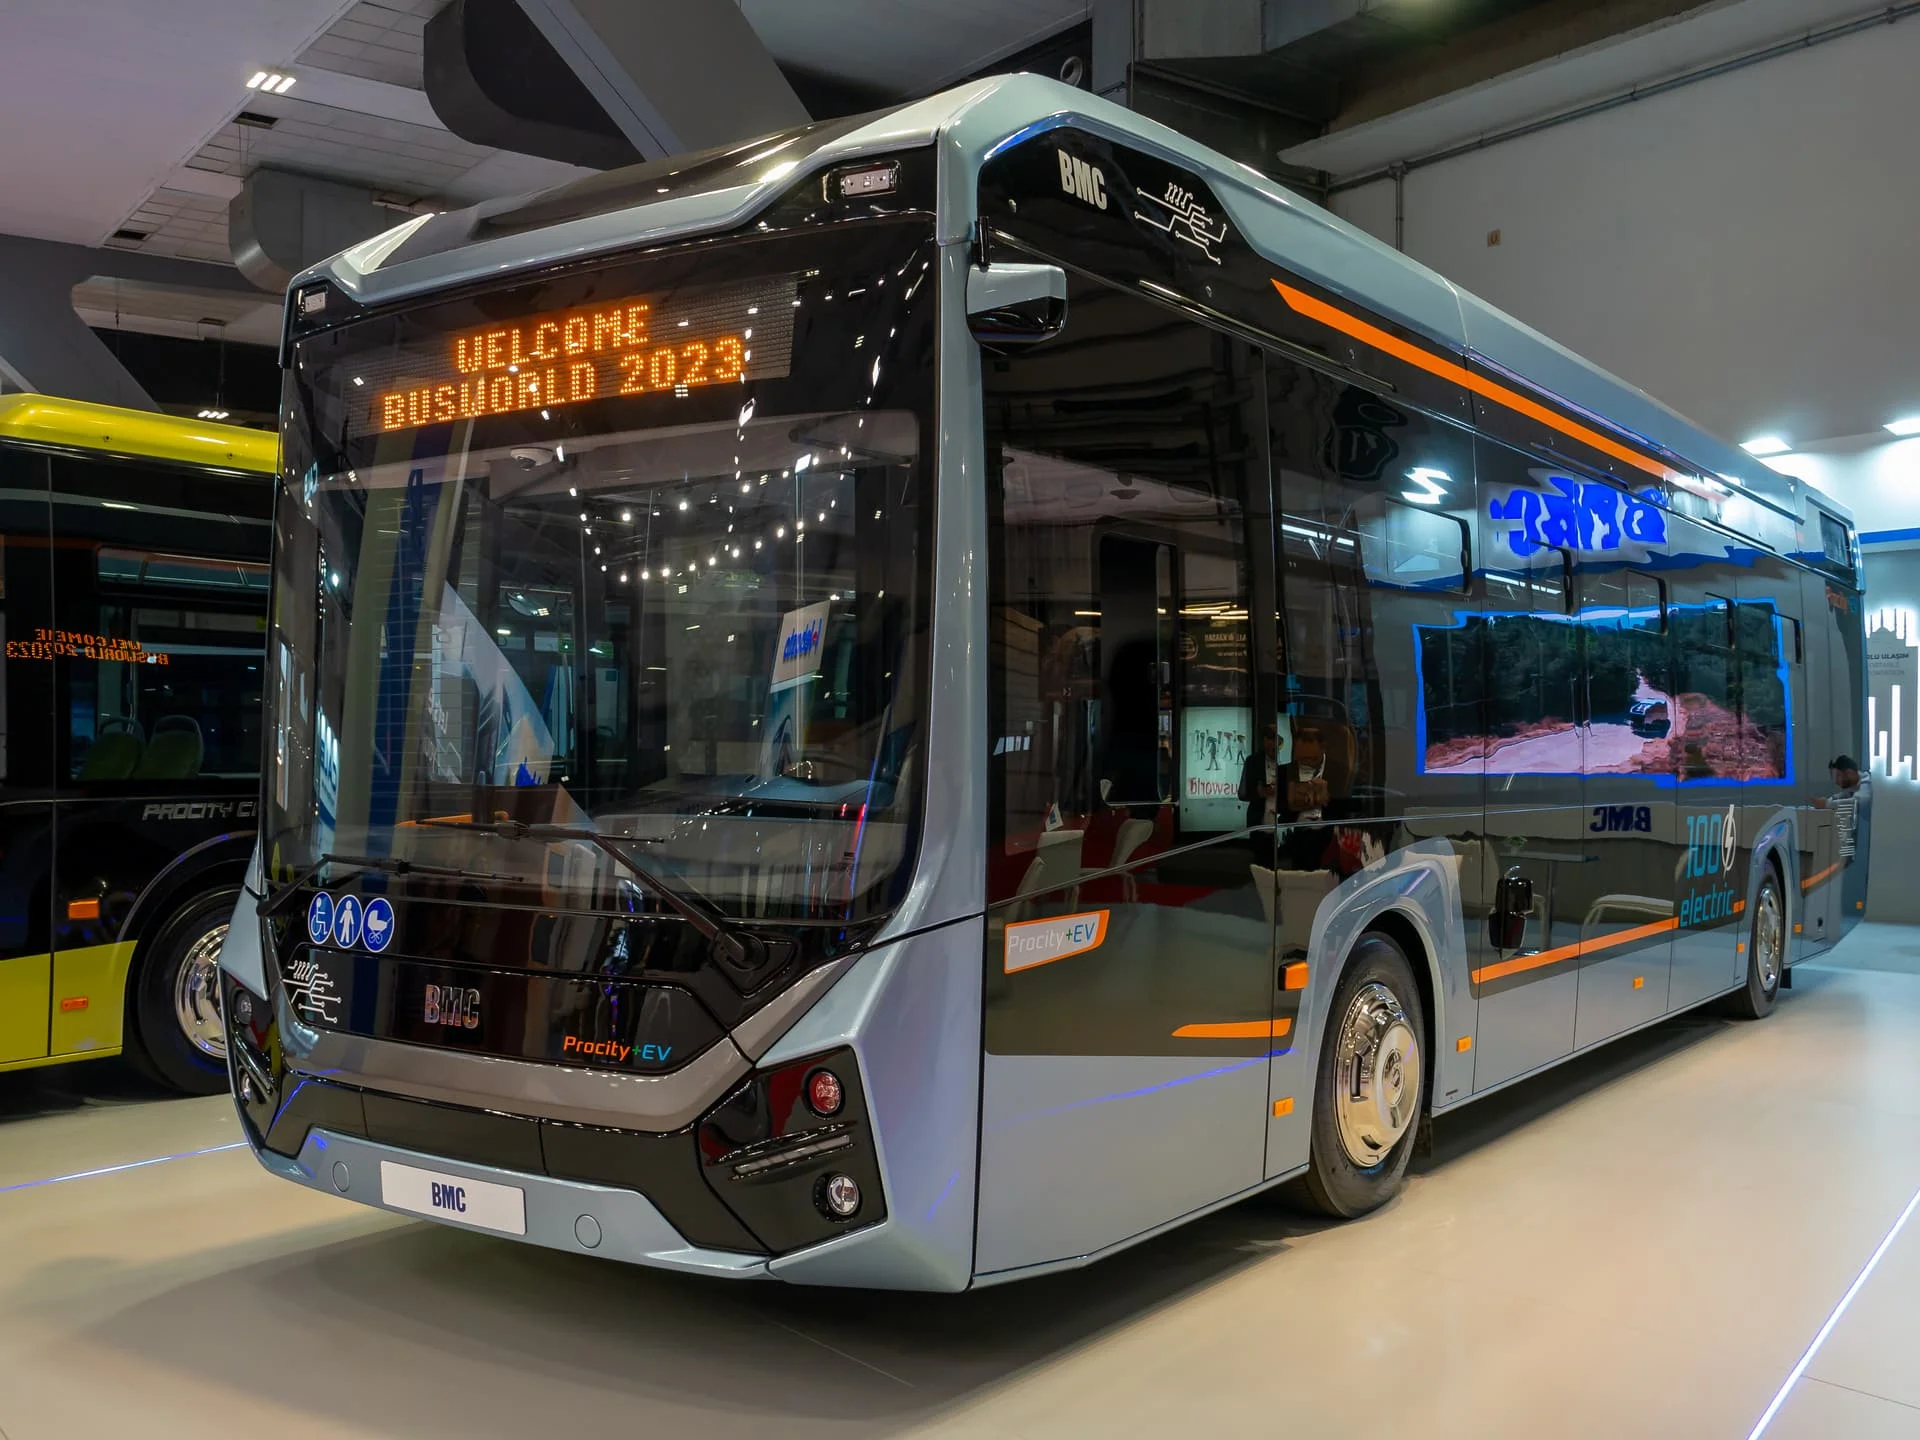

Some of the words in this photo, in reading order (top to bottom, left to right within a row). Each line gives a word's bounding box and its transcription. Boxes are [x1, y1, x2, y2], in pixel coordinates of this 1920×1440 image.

[1058, 149, 1107, 210] BMC
[457, 304, 649, 374] WELCOME
[383, 361, 596, 430] BUSWORLD
[620, 337, 743, 394] 2023
[142, 803, 233, 820] PROCITY
[1687, 813, 1722, 878] 100
[1680, 883, 1735, 927] electric
[424, 983, 480, 1030] BMC
[431, 1181, 467, 1214] BMC
